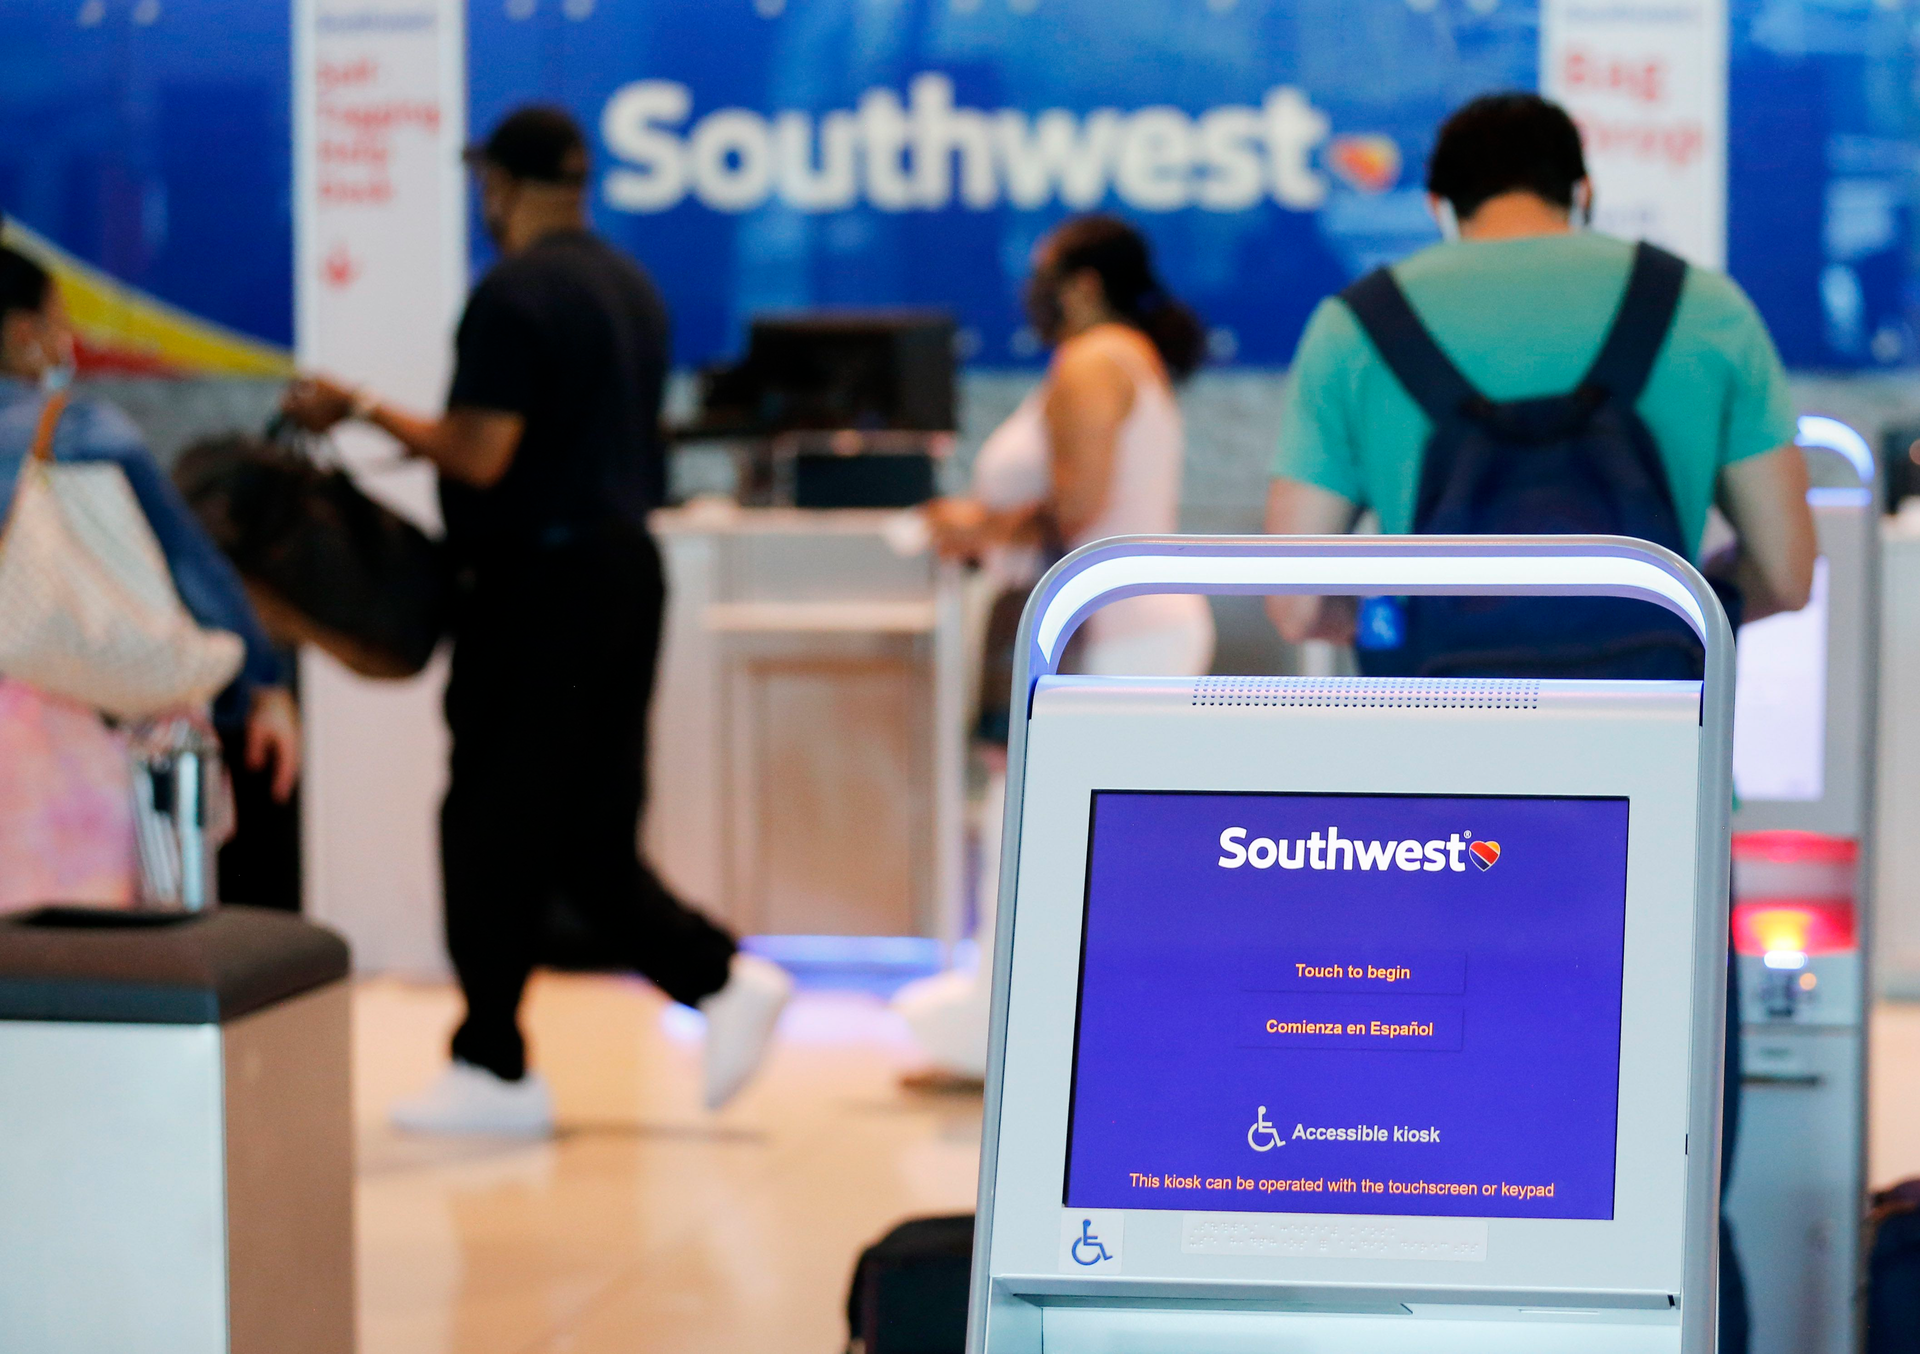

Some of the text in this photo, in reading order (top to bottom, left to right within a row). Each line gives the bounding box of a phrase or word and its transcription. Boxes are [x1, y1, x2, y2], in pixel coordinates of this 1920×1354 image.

[603, 73, 1330, 212] Southwest
[1218, 826, 1466, 872] Southwest
[1295, 963, 1411, 982] Touch to begin
[1266, 1019, 1434, 1039] Comienza en Español
[1291, 1124, 1441, 1143] Accessible kiosk
[1129, 1173, 1555, 1200] This kiosk can be operated with the touchscreen or keypad
